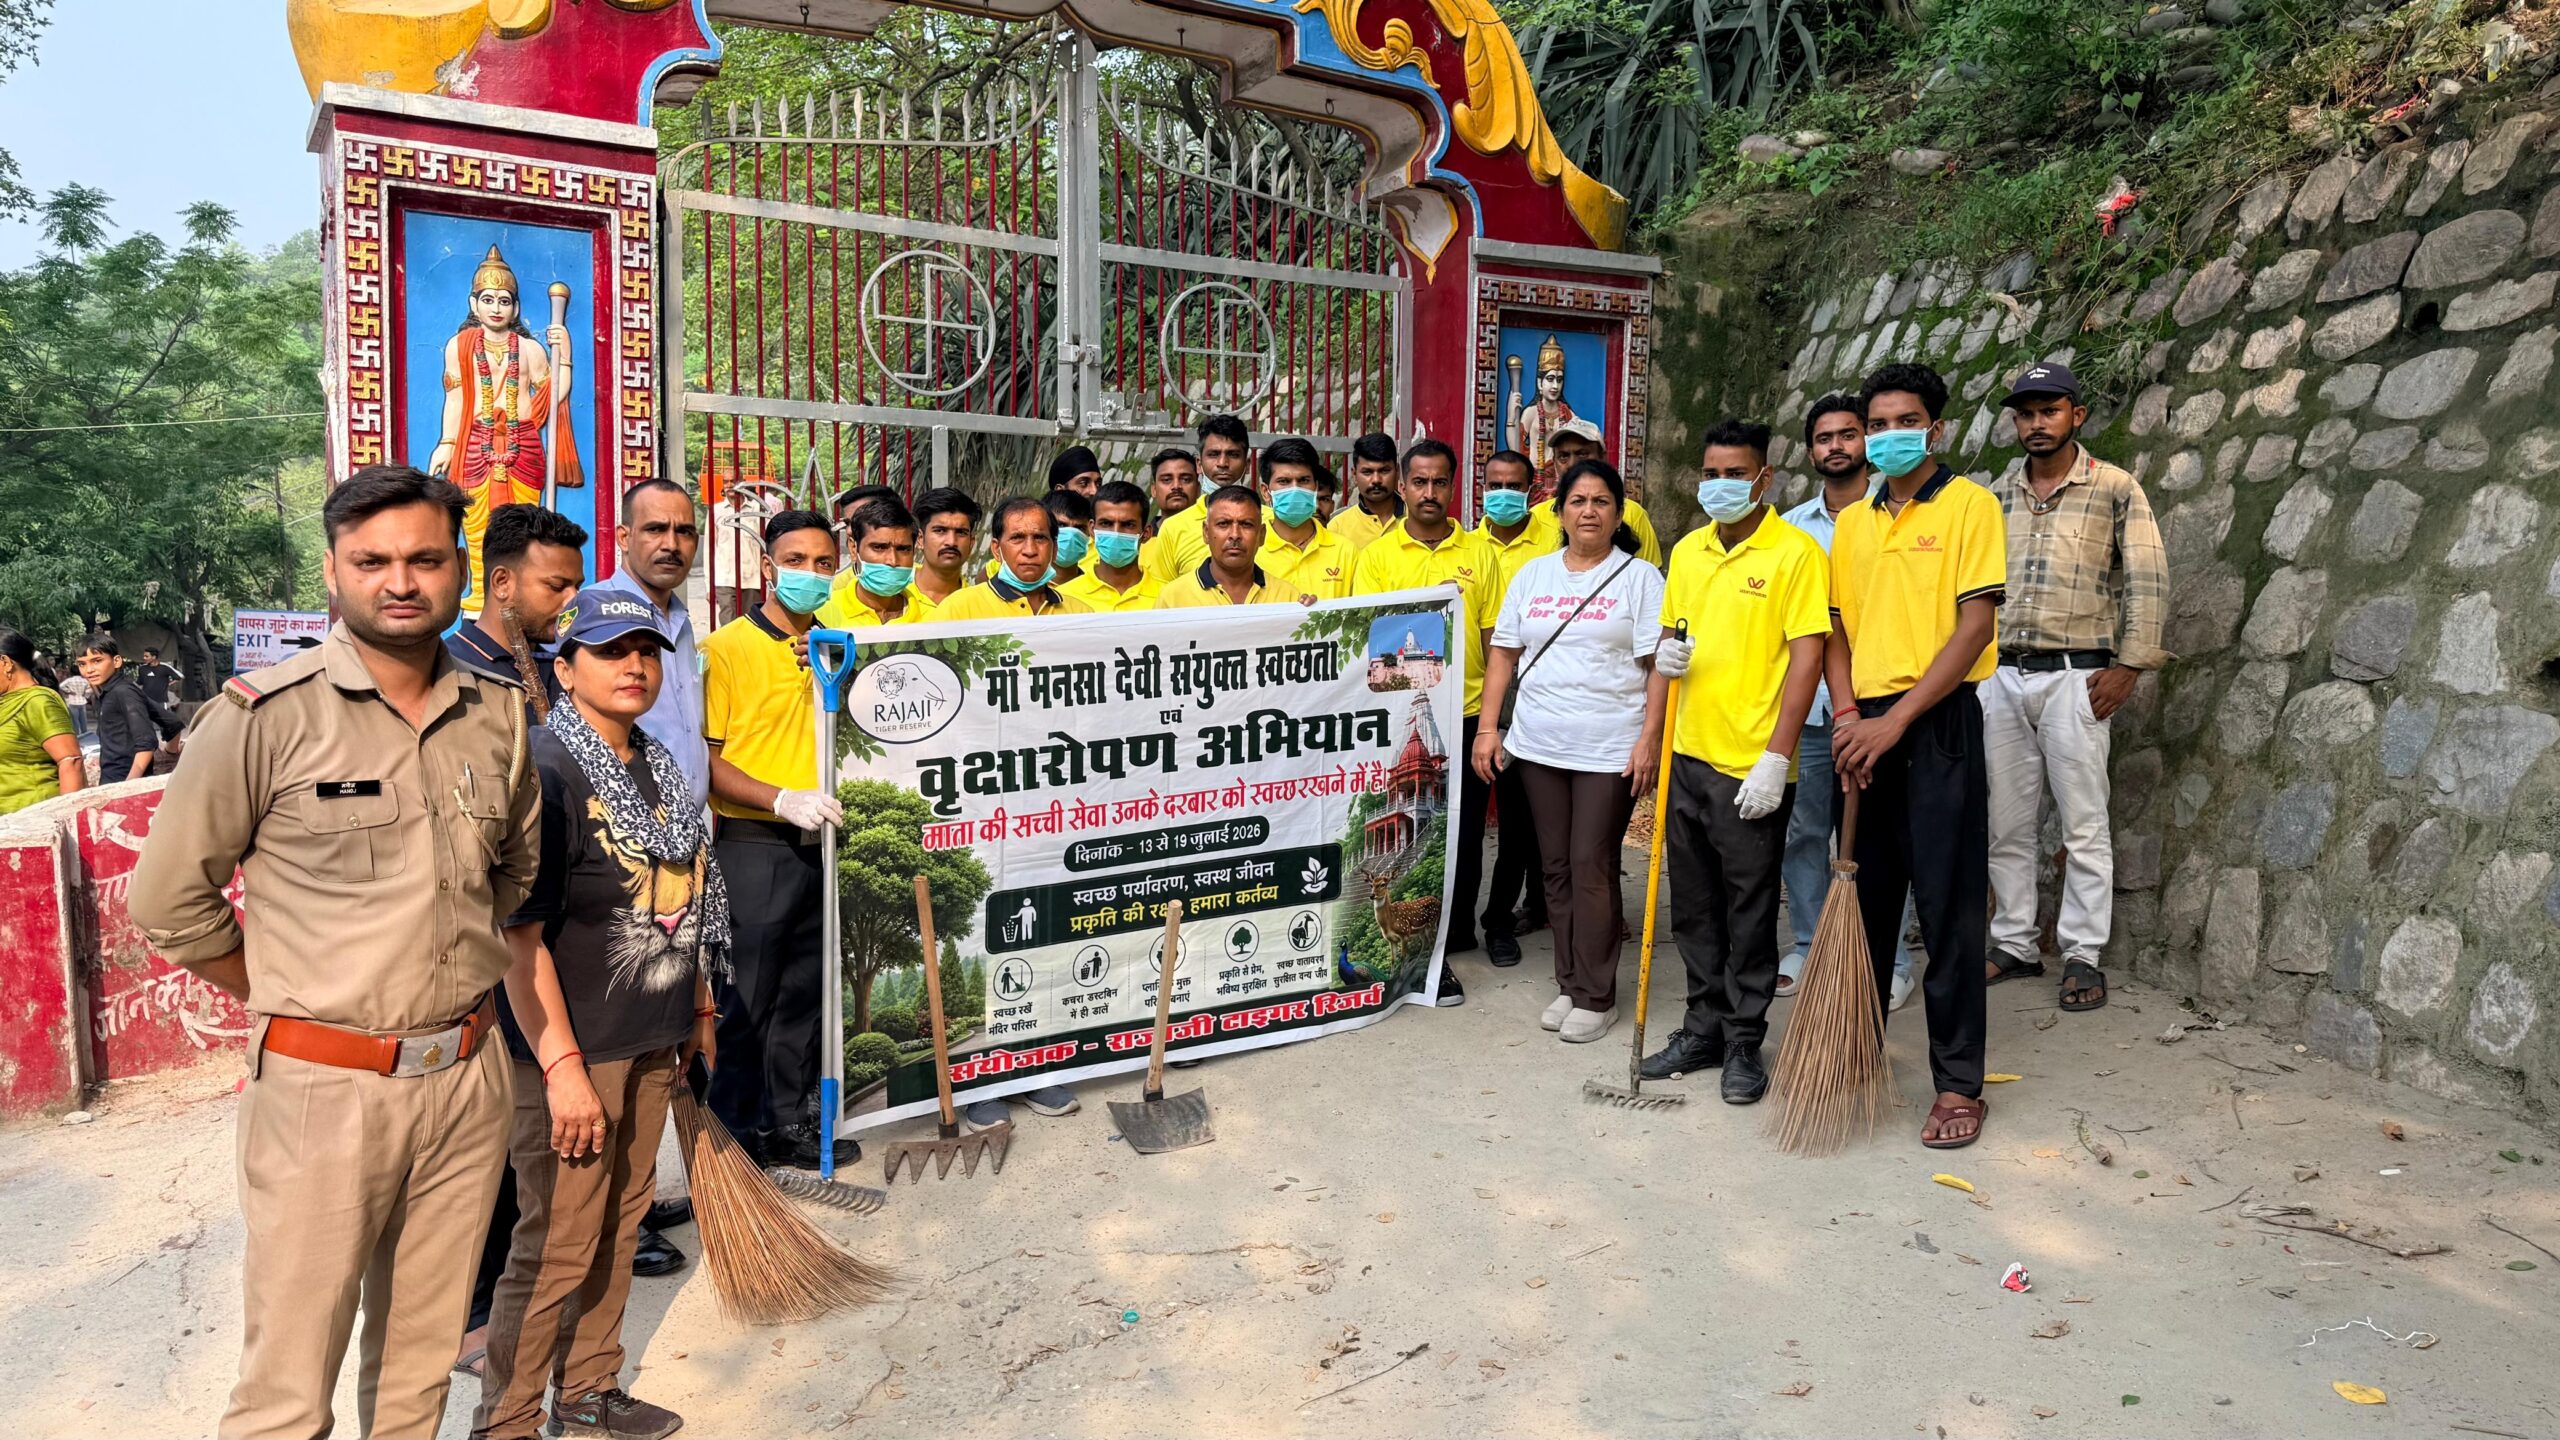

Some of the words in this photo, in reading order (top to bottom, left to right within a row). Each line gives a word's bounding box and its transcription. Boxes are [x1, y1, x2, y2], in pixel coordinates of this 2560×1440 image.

[601, 601, 652, 620] FOREST
[1526, 607, 1555, 619] for
[1558, 611, 1572, 620] a
[1573, 609, 1607, 622] job
[237, 617, 266, 630] वापस
[267, 615, 288, 631] जाने
[290, 620, 304, 631] का
[306, 618, 326, 632] मार्ग
[237, 634, 271, 648] EXIT
[1028, 661, 1106, 709] मनसा
[1114, 644, 1162, 700] देवी
[1170, 640, 1248, 709] संयुक्त
[1255, 641, 1339, 688] स्वच्छता
[874, 700, 931, 724] RAJAJI
[1159, 704, 1184, 725] एवं
[875, 724, 897, 733] TIGER
[900, 721, 932, 731] RESERVE
[916, 731, 1178, 815] वृक्षारोपण
[1196, 708, 1391, 768] अभियान
[923, 820, 974, 850] माता
[980, 807, 1007, 842] की
[1012, 799, 1063, 838] सच्ची
[1068, 797, 1107, 831] सेवा
[1111, 788, 1159, 825] उनके
[1163, 788, 1218, 819] दरबार
[1221, 777, 1246, 808] को
[1350, 761, 1369, 793] में
[1074, 840, 1123, 864] दिनांक
[1139, 840, 1153, 854] 13
[1156, 832, 1170, 851] से
[1174, 835, 1187, 848] 19
[1190, 823, 1229, 851] जुलाई
[1232, 824, 1260, 841] 2026
[1073, 885, 1117, 906] स्वच्छ
[1122, 873, 1189, 899] पर्यावरण,
[1193, 867, 1231, 888] स्वस्थ
[1235, 859, 1275, 882] जीवन
[1070, 906, 1117, 935] प्रकृति
[1122, 900, 1144, 924] की
[1149, 903, 1184, 920] रक्ष,
[1189, 892, 1231, 914] हमारा
[1235, 882, 1280, 906] कर्तव्य
[1219, 966, 1241, 982] प्रकृति
[1242, 964, 1249, 976] से
[1216, 983, 1240, 996] भविष्य
[1242, 977, 1267, 994] सुरक्षित
[1061, 994, 1084, 1007] कचरा
[1087, 987, 1118, 1001] डस्टबिन
[993, 1006, 1016, 1019] स्वच्छ
[1019, 1001, 1033, 1014] रखें
[1080, 1006, 1088, 1018] ही
[1092, 1003, 1109, 1016] डालें
[949, 1040, 1077, 1083] संयोजक
[1220, 1000, 1309, 1031] टाइगर
[1313, 981, 1385, 1018] रिजर्व
[988, 1023, 1008, 1036] मंदिर
[1011, 1019, 1038, 1032] परिसर
